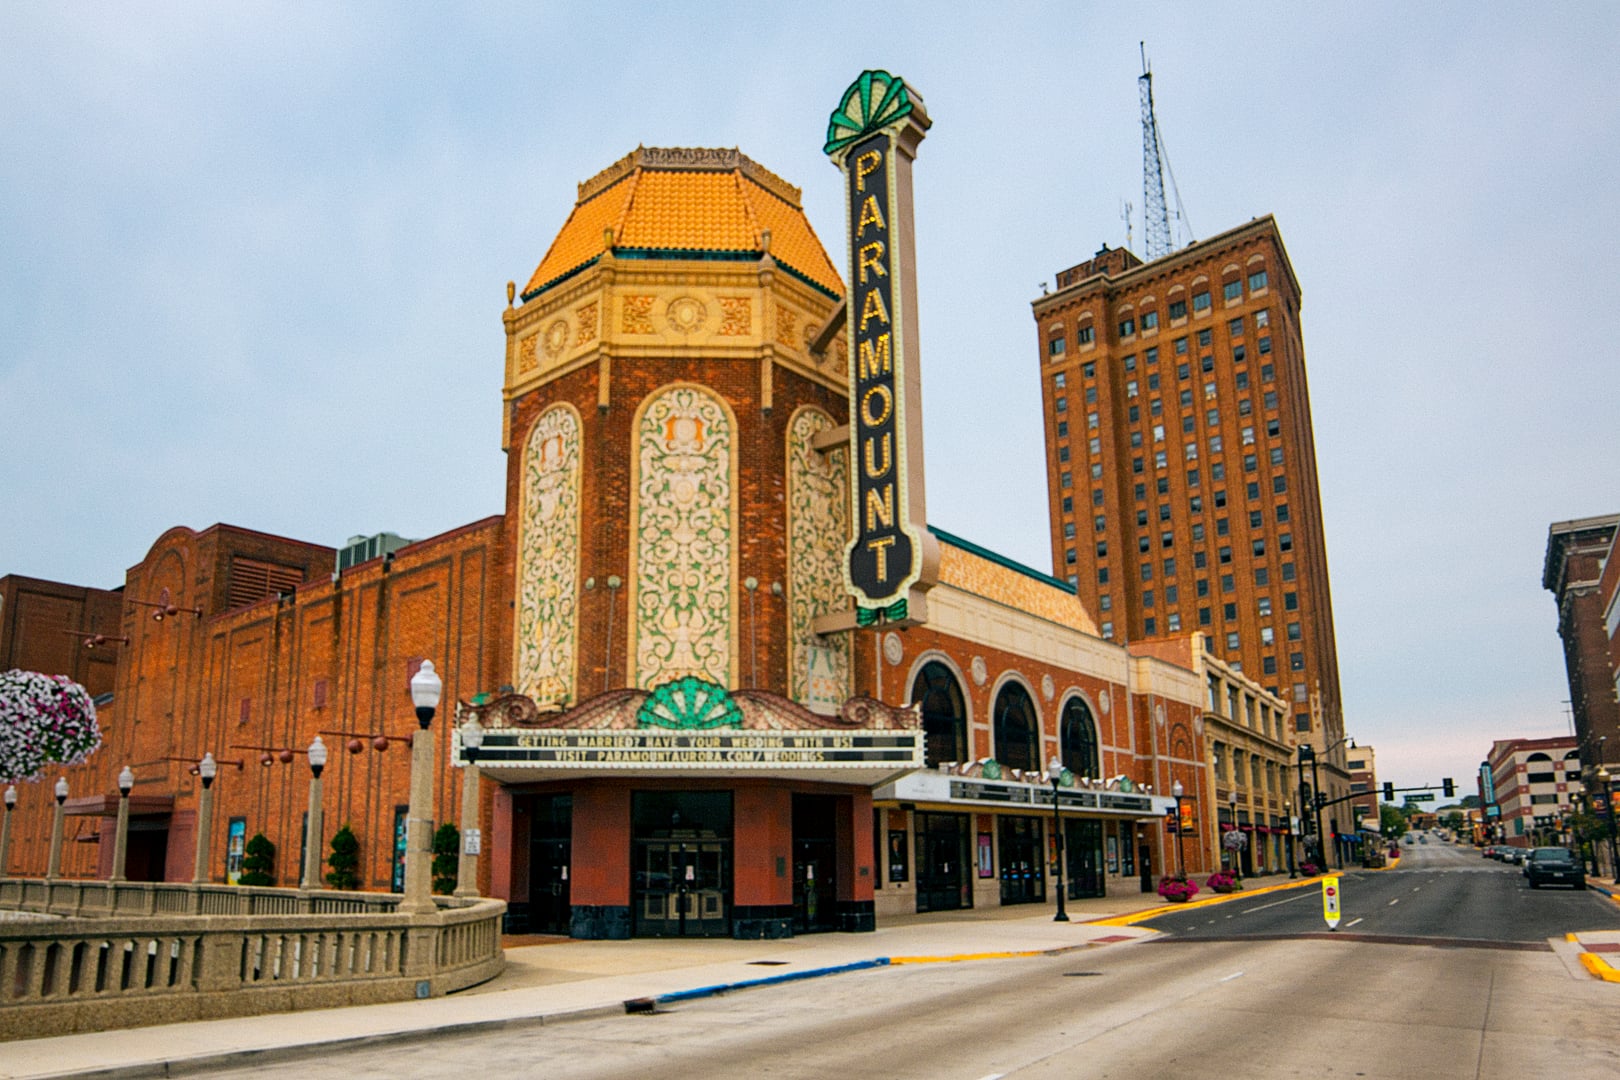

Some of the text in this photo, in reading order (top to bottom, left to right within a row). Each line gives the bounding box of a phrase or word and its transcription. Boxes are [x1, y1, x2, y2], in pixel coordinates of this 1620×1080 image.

[855, 149, 896, 583] PARAMOUNT
[517, 735, 568, 747] GETTING
[577, 736, 640, 747] MARRIED?
[645, 736, 678, 747] HAVE
[688, 736, 721, 747] YOUR
[731, 736, 784, 747] WEDDING
[793, 736, 824, 747] WITH
[555, 751, 587, 761] VISIT
